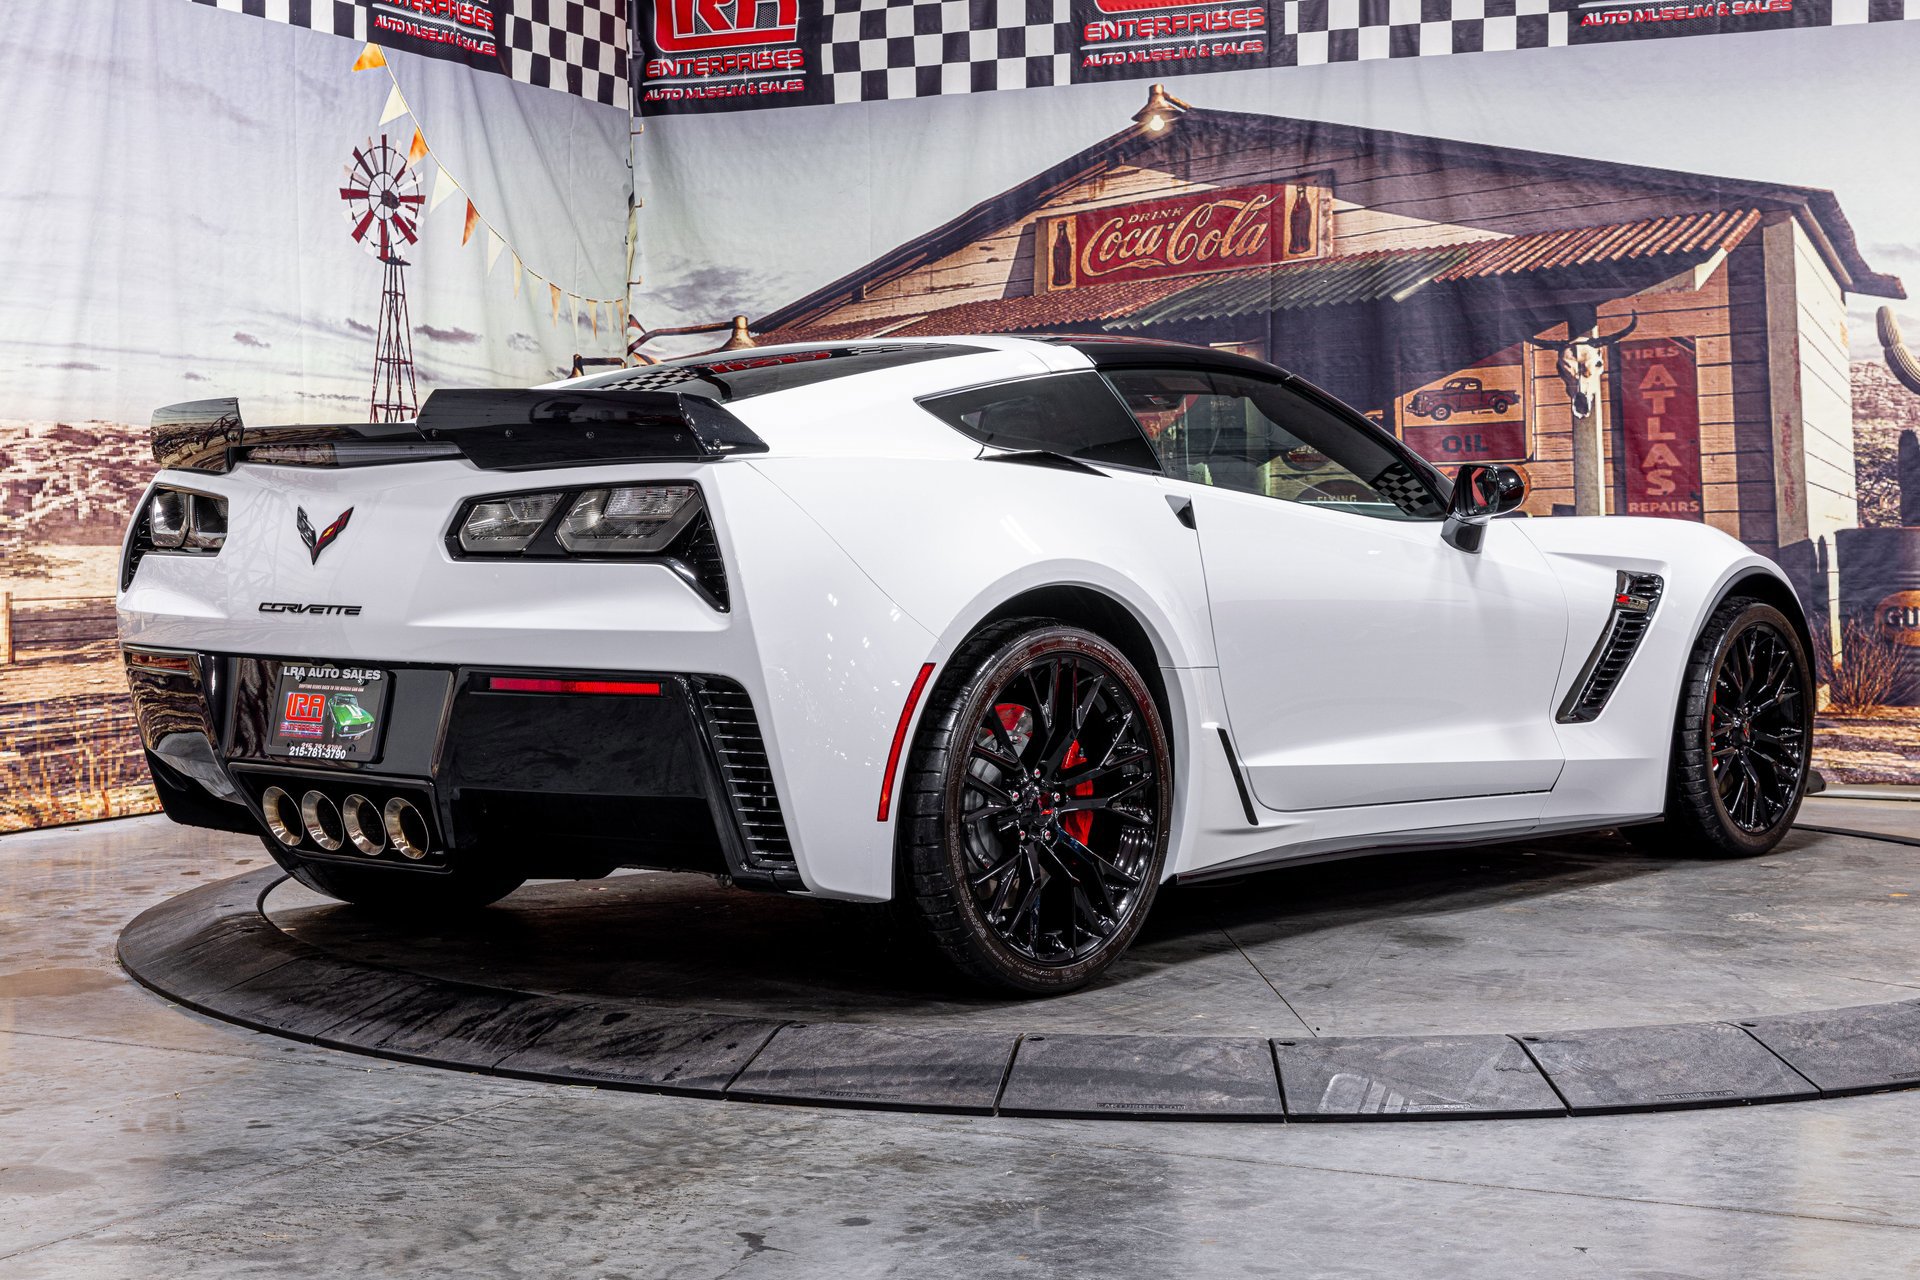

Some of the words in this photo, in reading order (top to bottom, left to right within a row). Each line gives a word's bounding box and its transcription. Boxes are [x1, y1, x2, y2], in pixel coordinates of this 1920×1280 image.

[1083, 6, 1265, 42] ENTERPRISES
[1580, 9, 1632, 26] AUTO
[1633, 4, 1714, 22] MUSEUM
[1717, 2, 1729, 16] &
[1732, 0, 1793, 15] SALES
[373, 15, 405, 33] AUTO
[406, 22, 454, 45] MUSEUM
[646, 48, 805, 78] ENTERPRISES
[1082, 53, 1126, 68] AUTO
[1127, 46, 1196, 64] MUSEUM
[1198, 44, 1210, 57] &
[1212, 40, 1264, 56] SALES
[644, 88, 683, 101] AUTO
[685, 84, 745, 100] MUSEUM
[747, 83, 758, 95] &
[759, 79, 805, 94] SALES
[1128, 206, 1184, 224] DRINK
[1081, 193, 1280, 277] Coca-Cola
[1622, 346, 1679, 360] TIRES
[1638, 364, 1682, 495] ATLAS
[1442, 434, 1488, 453] OIL
[1628, 501, 1700, 513] REPAIRS
[258, 602, 363, 616] CORVETTE
[284, 666, 305, 677] LRA
[308, 667, 339, 679] AUTO
[343, 668, 381, 680] SALES
[285, 692, 326, 723] LRA
[289, 746, 346, 760] 215-781-3790
